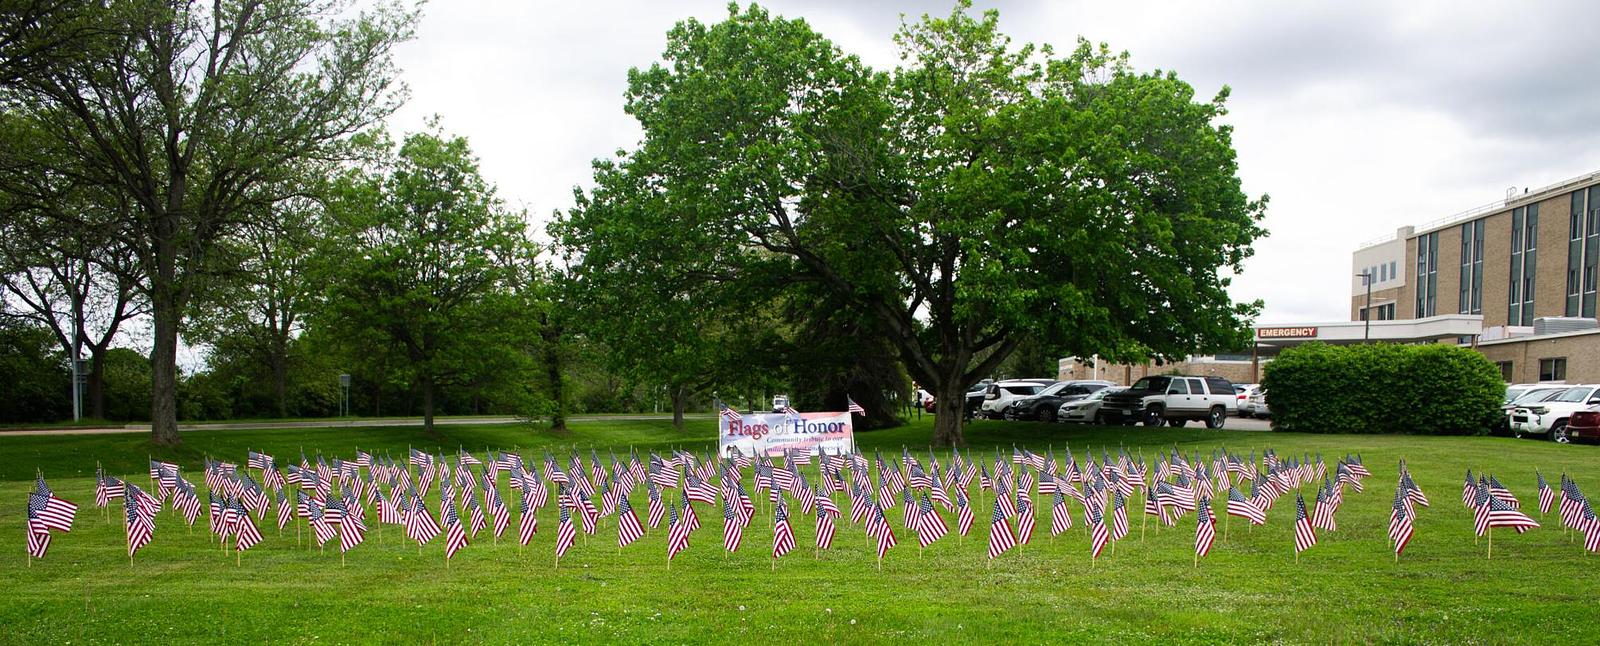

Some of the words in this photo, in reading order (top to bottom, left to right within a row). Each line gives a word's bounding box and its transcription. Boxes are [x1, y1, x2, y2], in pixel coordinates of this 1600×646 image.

[1260, 328, 1314, 336] EMERGENCY
[728, 419, 769, 440] Flags
[774, 417, 792, 436] of
[793, 418, 846, 434] Honor
[766, 436, 802, 444] Community
